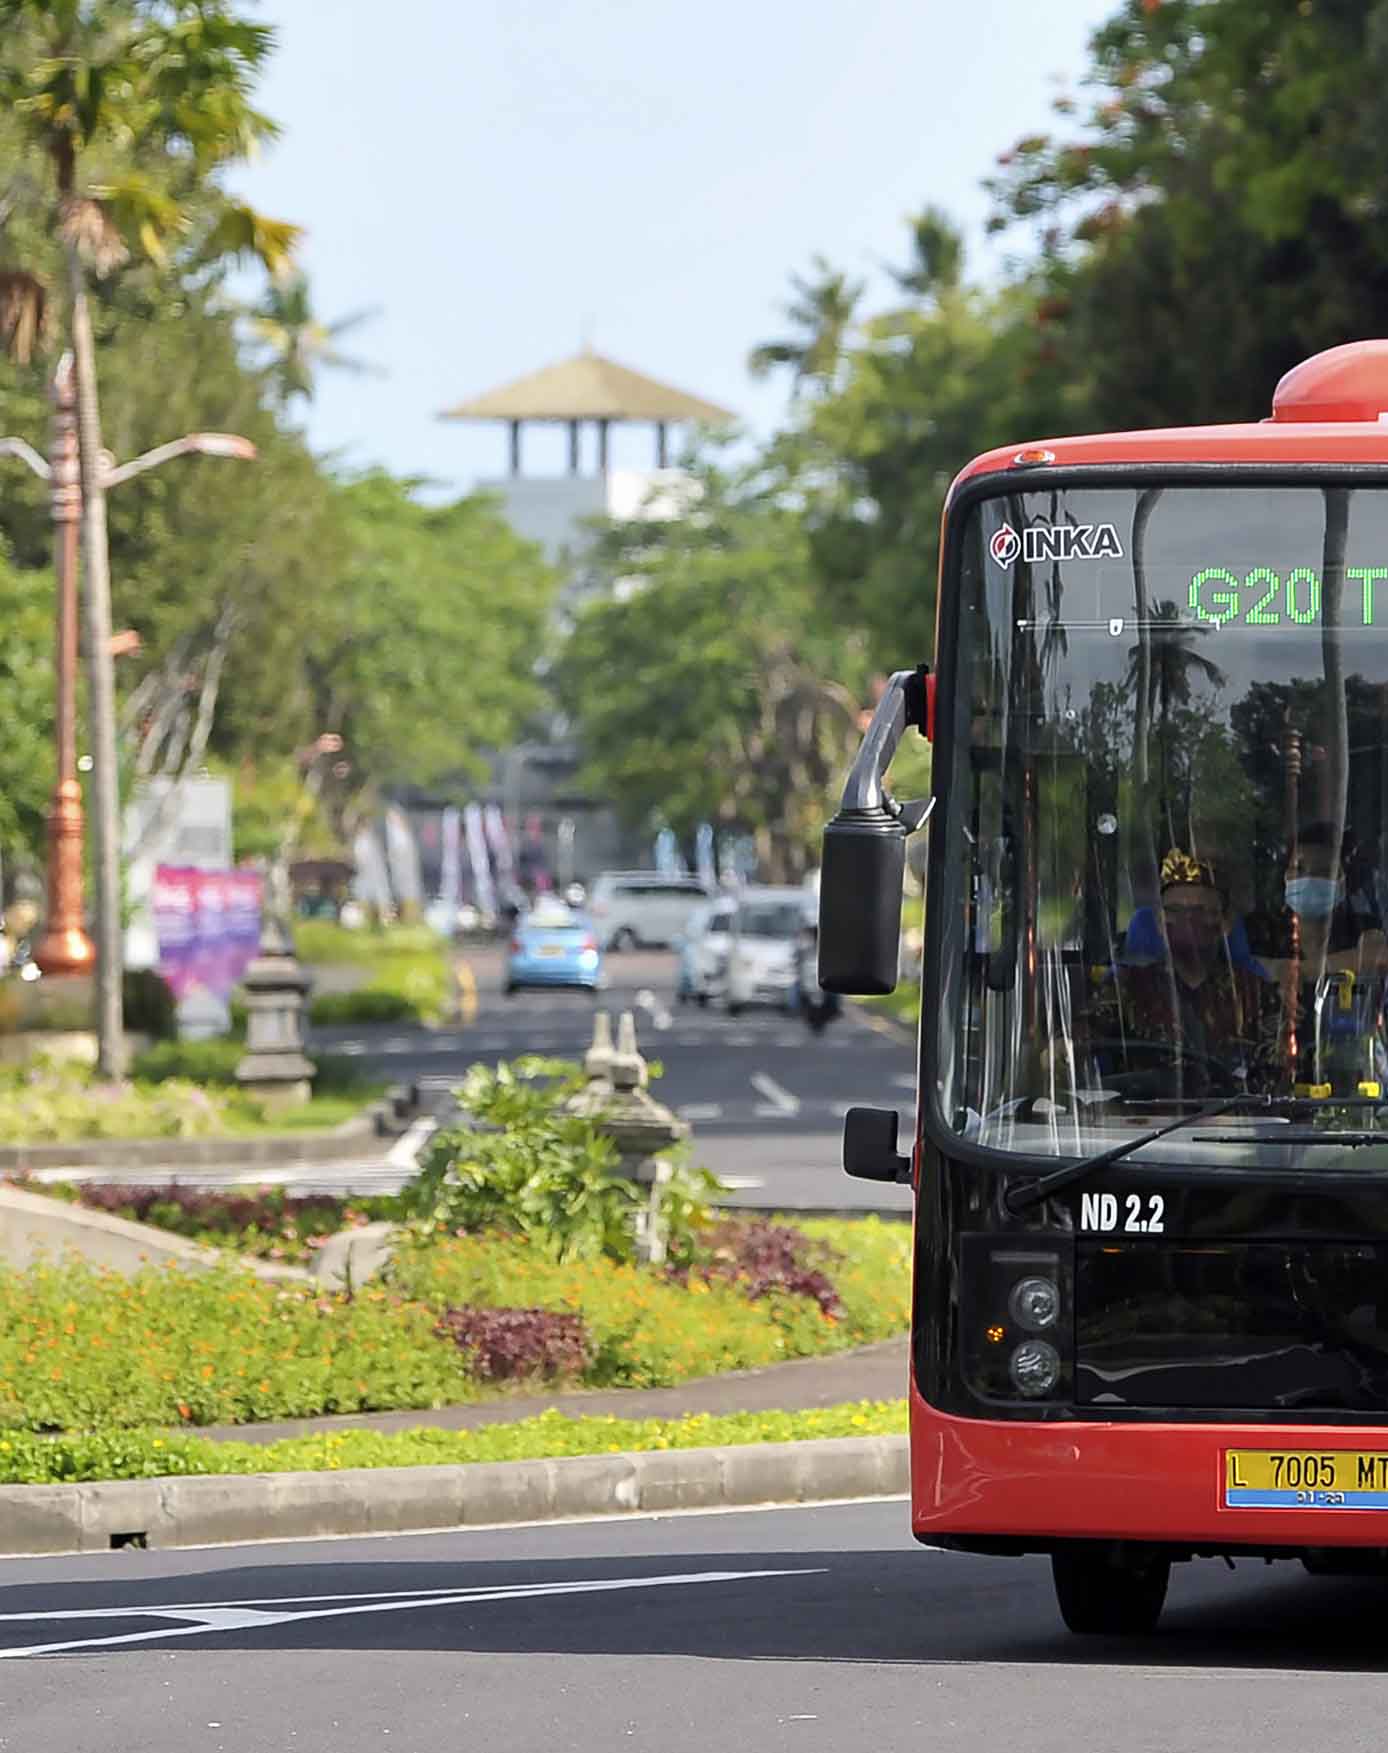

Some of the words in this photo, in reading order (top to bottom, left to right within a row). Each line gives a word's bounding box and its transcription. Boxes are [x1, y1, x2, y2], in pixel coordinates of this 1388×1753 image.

[1023, 524, 1124, 562] INKA
[1188, 567, 1321, 624] G20
[1081, 1193, 1118, 1231] ND
[1124, 1194, 1164, 1232] 2.2
[1231, 1456, 1247, 1487] L
[1269, 1456, 1335, 1487] 7005
